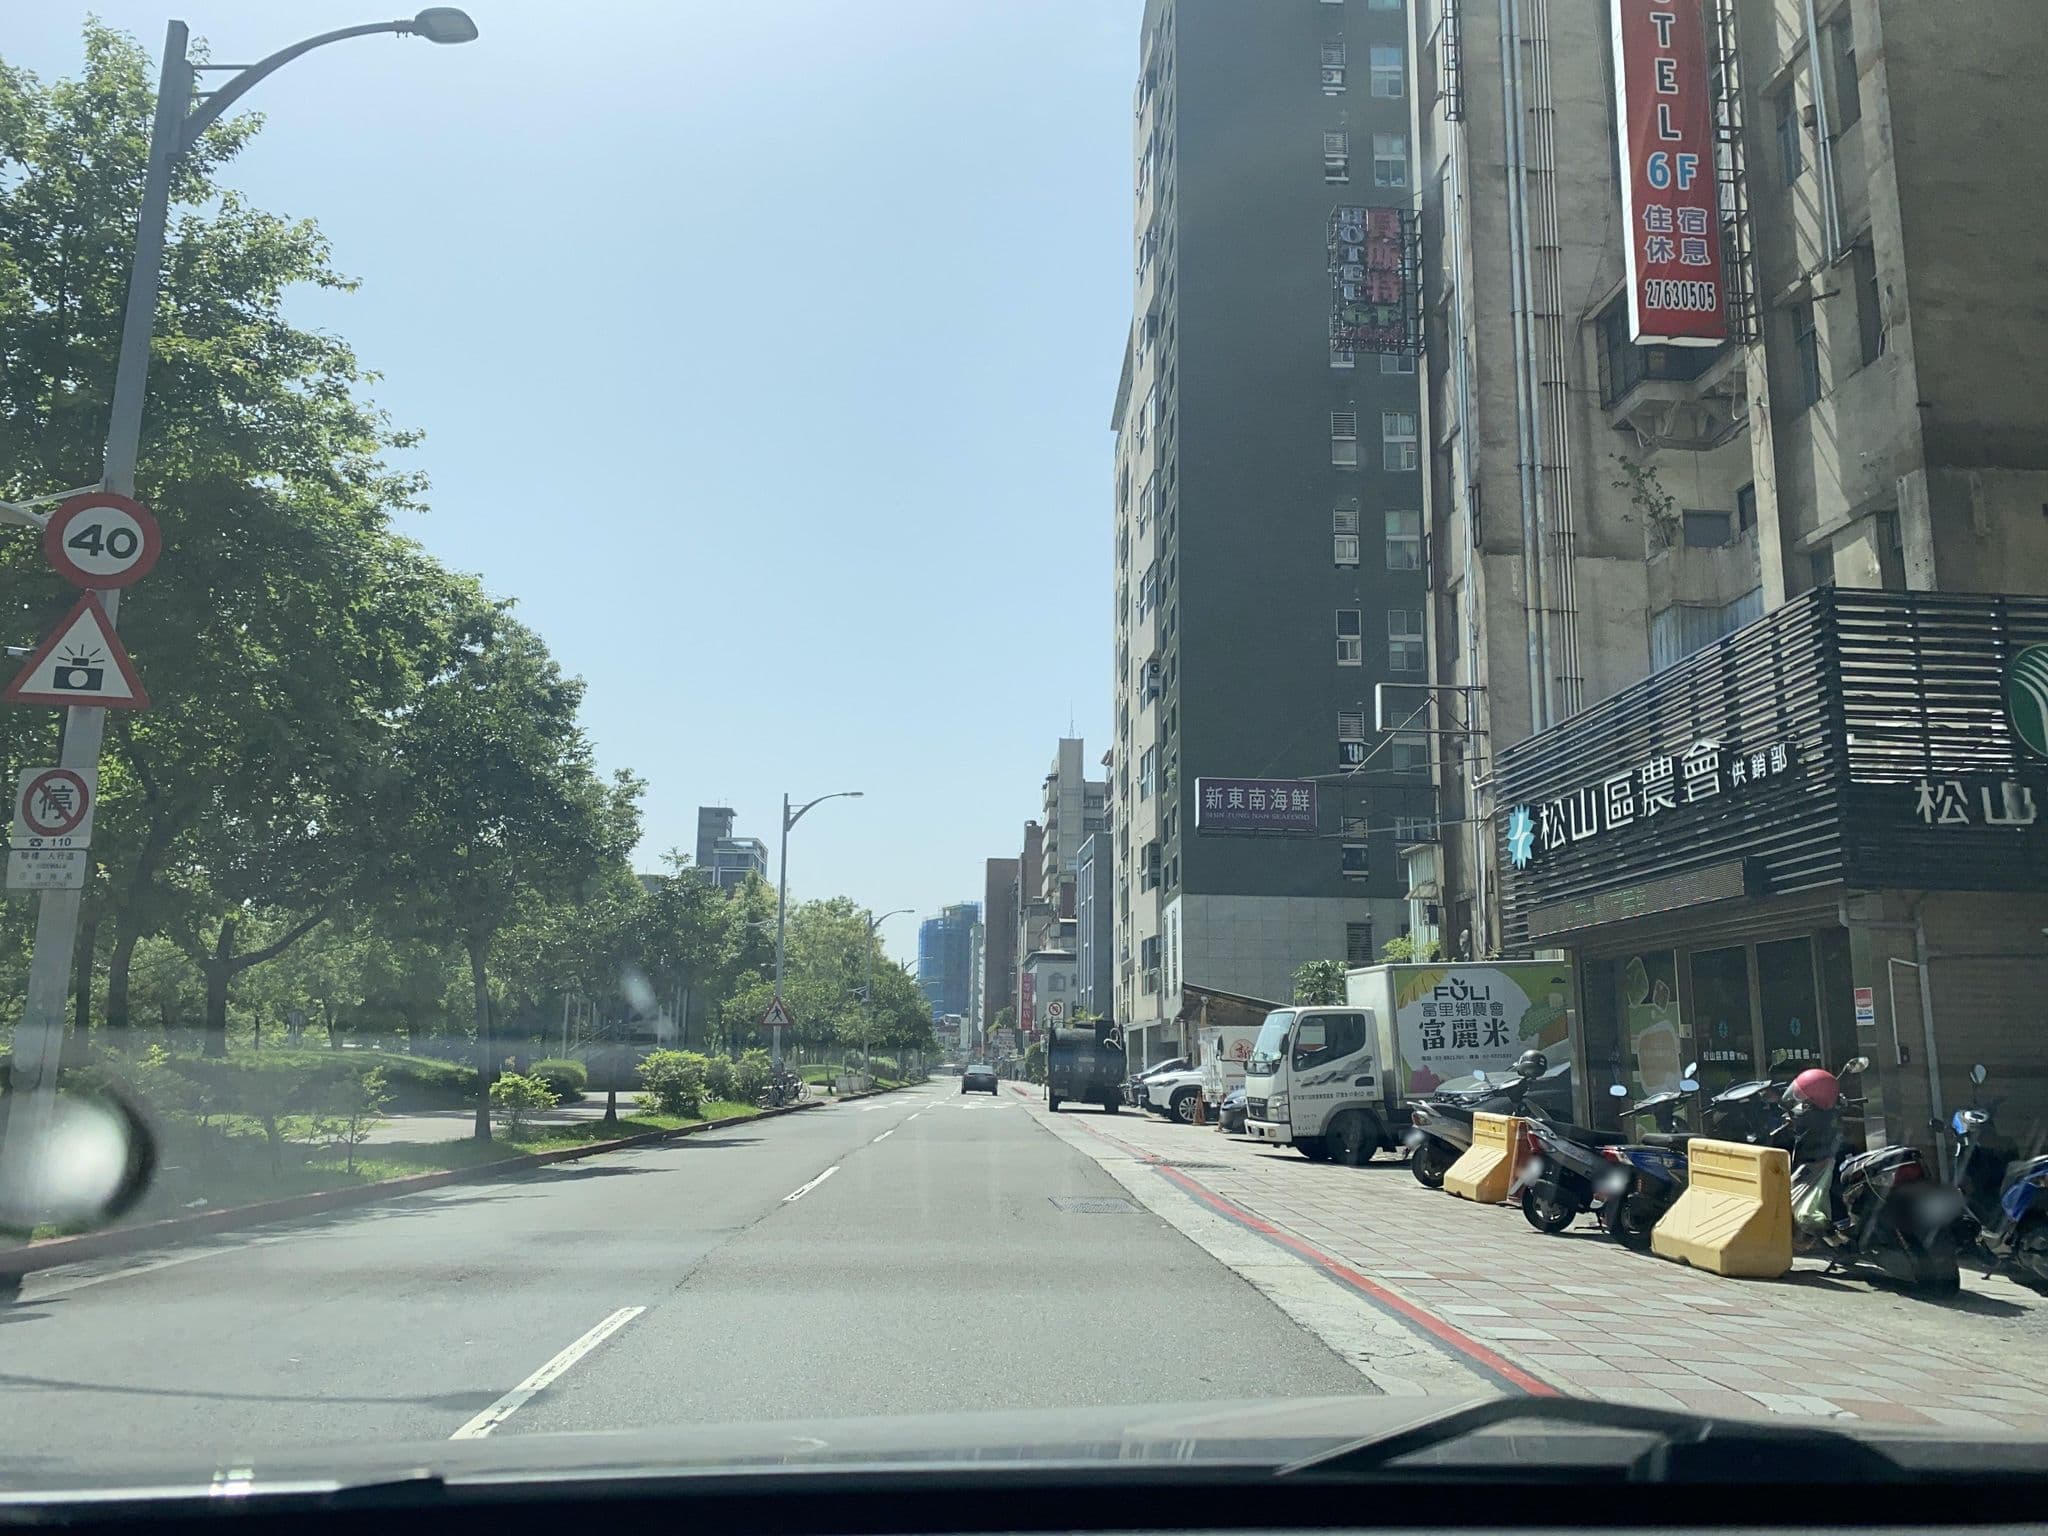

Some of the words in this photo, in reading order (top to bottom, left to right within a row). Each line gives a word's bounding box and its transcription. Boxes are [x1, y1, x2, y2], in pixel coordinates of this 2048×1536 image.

[1649, 0, 1682, 142] TEL
[1647, 152, 1699, 192] 6F
[1643, 203, 1708, 235] 住宿
[1644, 236, 1710, 266] 休息
[1645, 279, 1716, 312] 27630505
[68, 524, 138, 559] 40
[1205, 786, 1310, 812] 新東南海鮮
[1538, 739, 1722, 851] 松山區農會
[1731, 743, 1788, 788] 供銷部
[1914, 778, 2038, 827] 松山
[51, 837, 72, 847] 110
[1418, 1017, 1510, 1051] 富麗米
